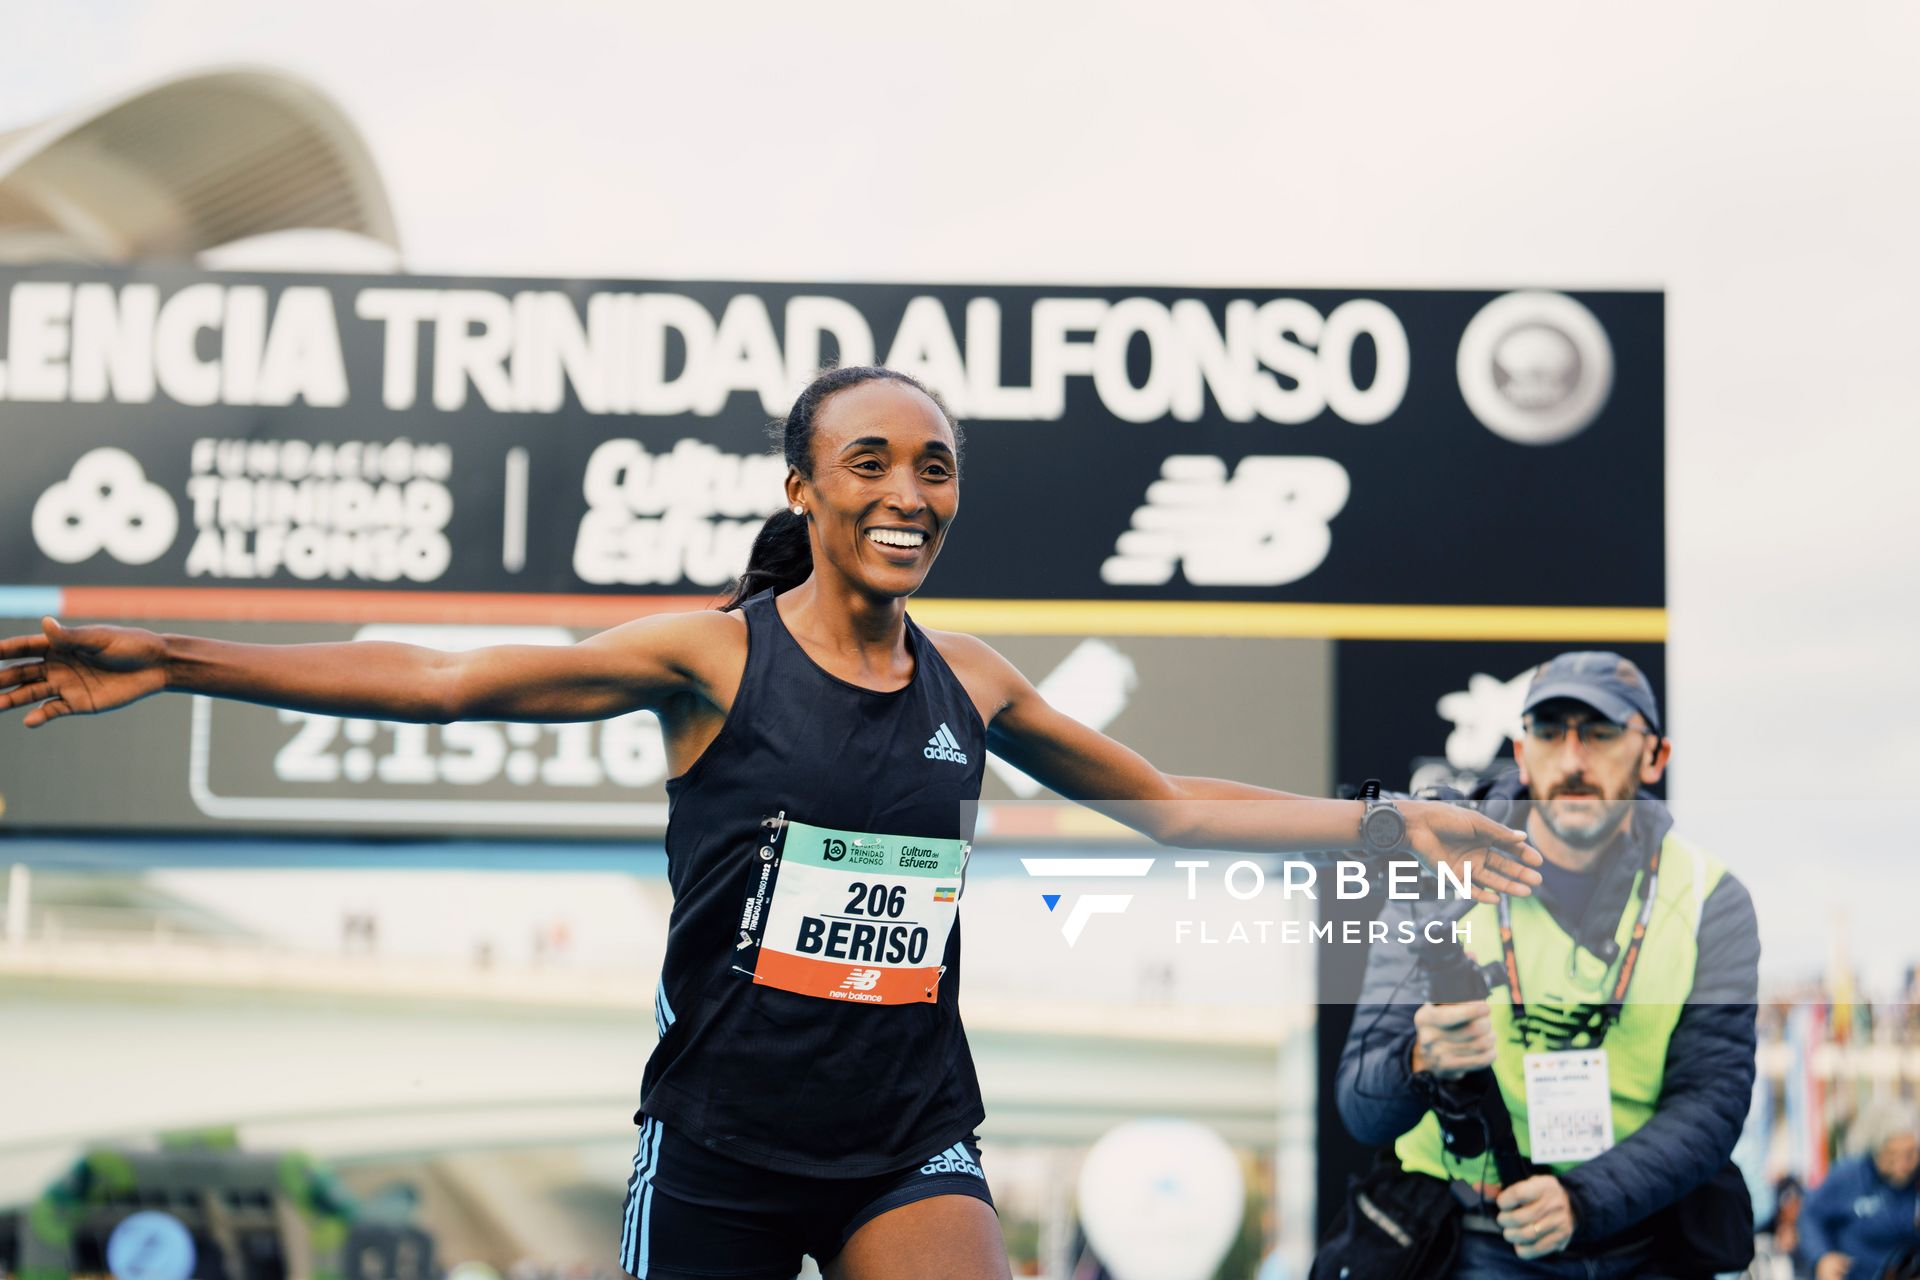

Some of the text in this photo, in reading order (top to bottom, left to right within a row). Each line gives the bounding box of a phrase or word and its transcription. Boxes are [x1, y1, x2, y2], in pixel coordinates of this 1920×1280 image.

[0, 281, 1410, 424] ENCIA TRINIDAD ALFONSO
[188, 475, 452, 531] TRINIDAD
[187, 527, 451, 582] ALFONSO
[274, 706, 668, 787] 2:15:16
[923, 746, 968, 765] adidas
[848, 857, 884, 866] ALFONSO
[850, 848, 885, 859] TRINIDAD
[899, 857, 938, 869] Esfuerzo
[901, 845, 932, 858] Cultura
[761, 863, 772, 881] 2022
[755, 881, 767, 906] ALFONSO
[844, 882, 907, 918] 206
[741, 897, 755, 929] VALENCIA
[749, 905, 762, 931] TRINIDAD
[795, 915, 929, 965] BERISO
[829, 990, 883, 1003] new balance
[920, 1158, 985, 1180] adidas
